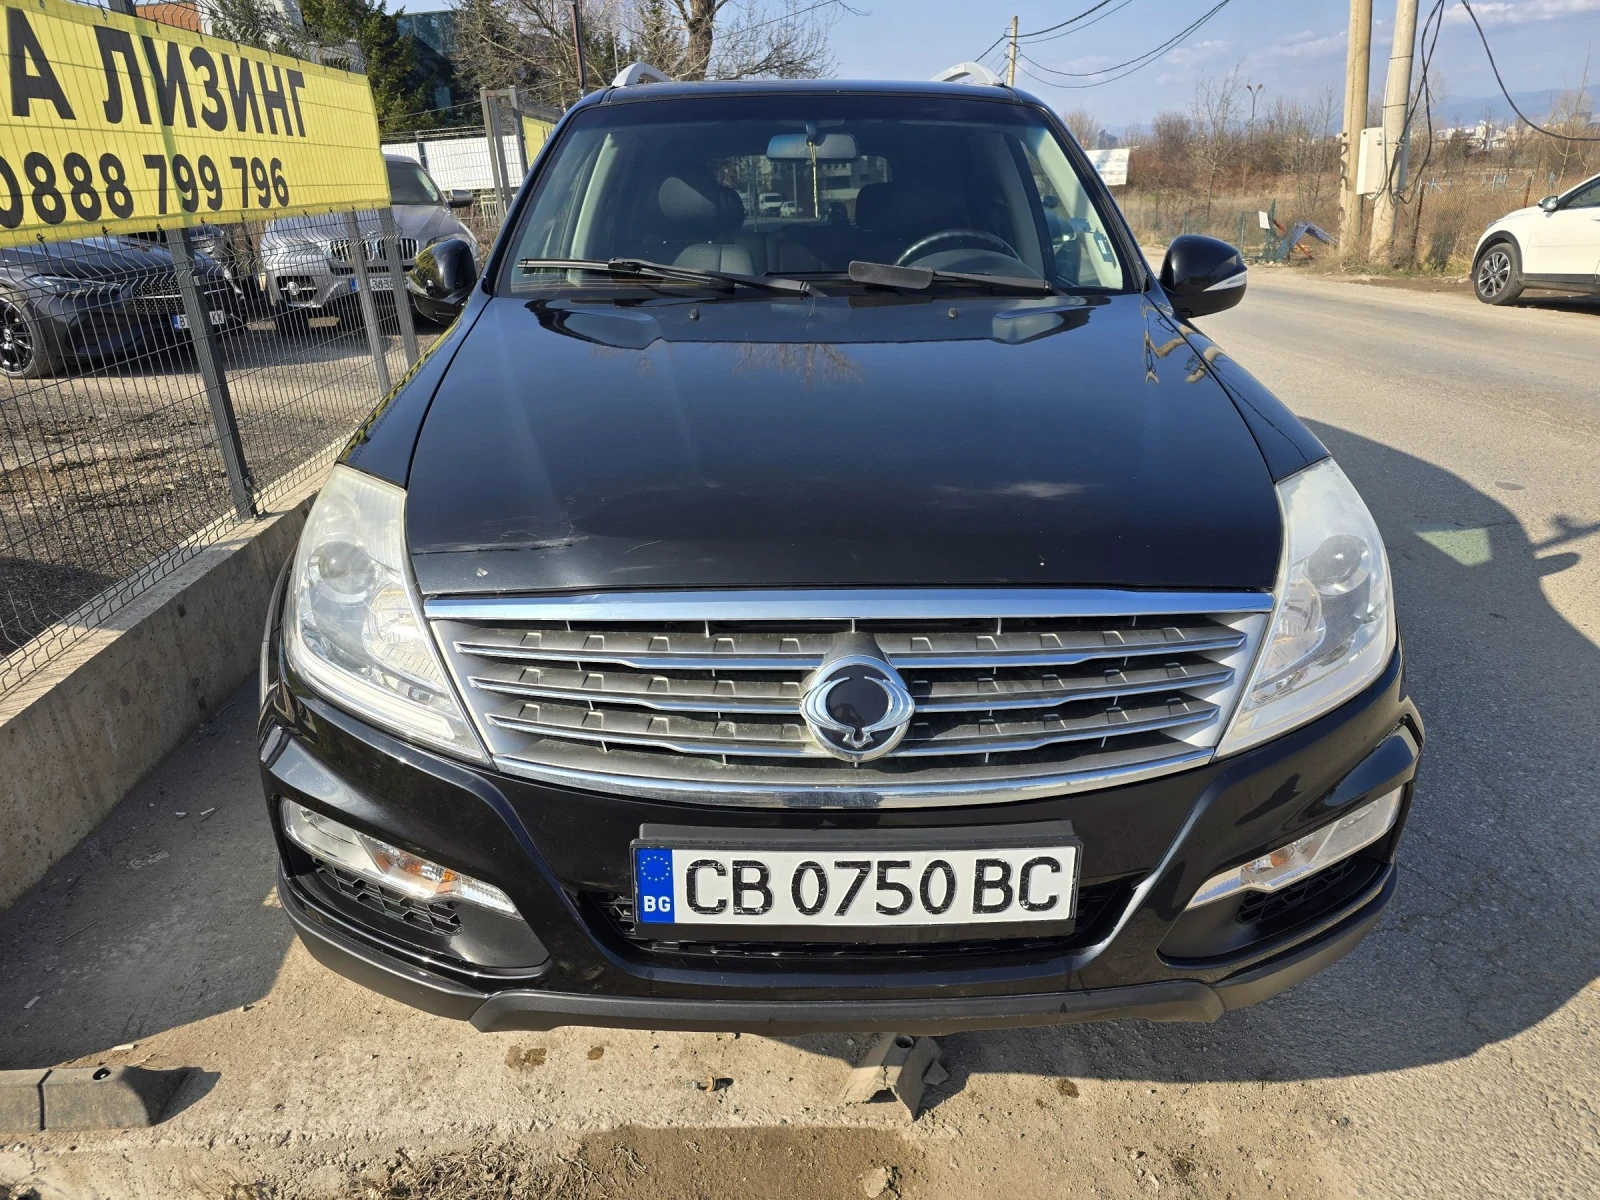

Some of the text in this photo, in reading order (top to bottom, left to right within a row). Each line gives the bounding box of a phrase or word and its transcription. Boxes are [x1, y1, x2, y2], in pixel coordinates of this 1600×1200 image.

[93, 25, 305, 137] ЛИЗИНГ
[0, 152, 289, 229] 0888 799 796
[643, 895, 671, 913] BG
[686, 856, 1061, 916] CB 0750 BC
